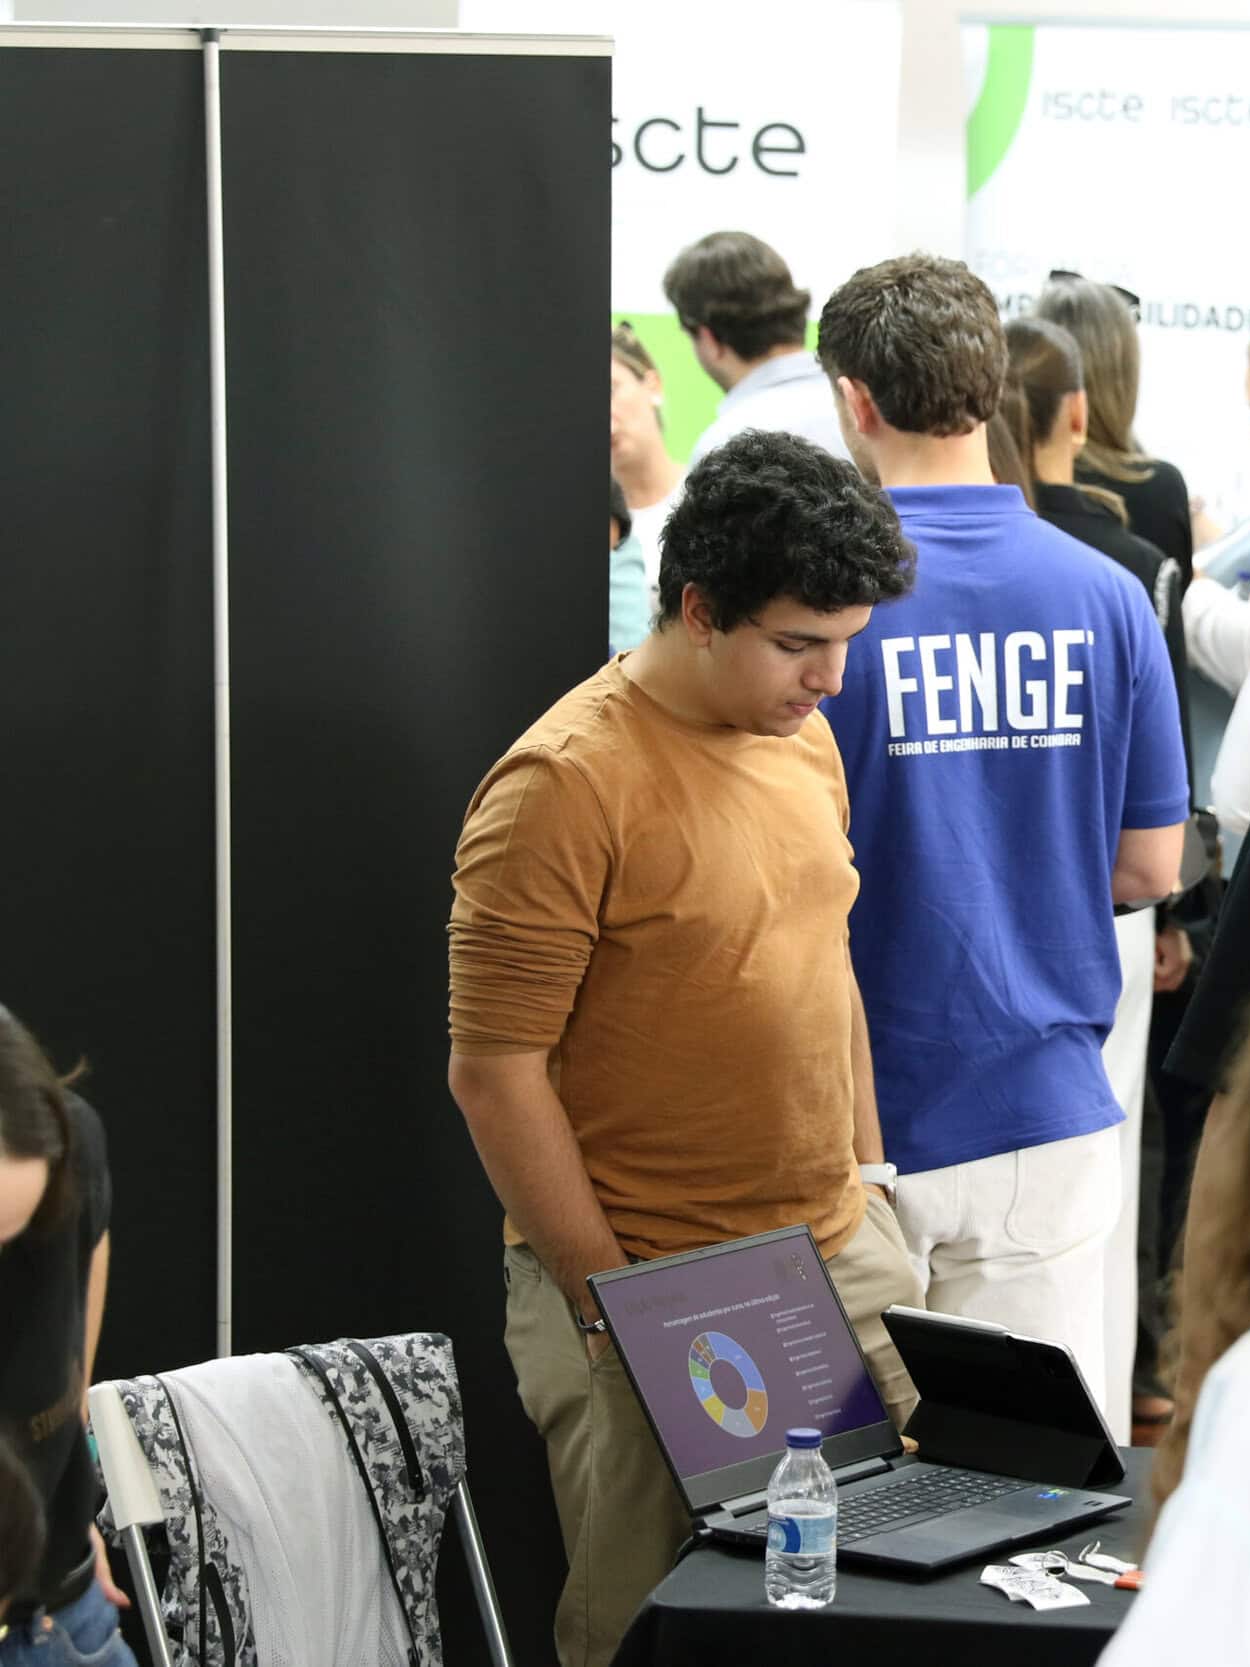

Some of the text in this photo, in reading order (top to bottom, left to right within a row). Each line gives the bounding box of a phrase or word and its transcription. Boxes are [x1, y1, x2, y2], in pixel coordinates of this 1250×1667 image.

[611, 106, 806, 177] cte
[888, 733, 1082, 757] FEIRA DE ENGENHARIA DE COIMBRA
